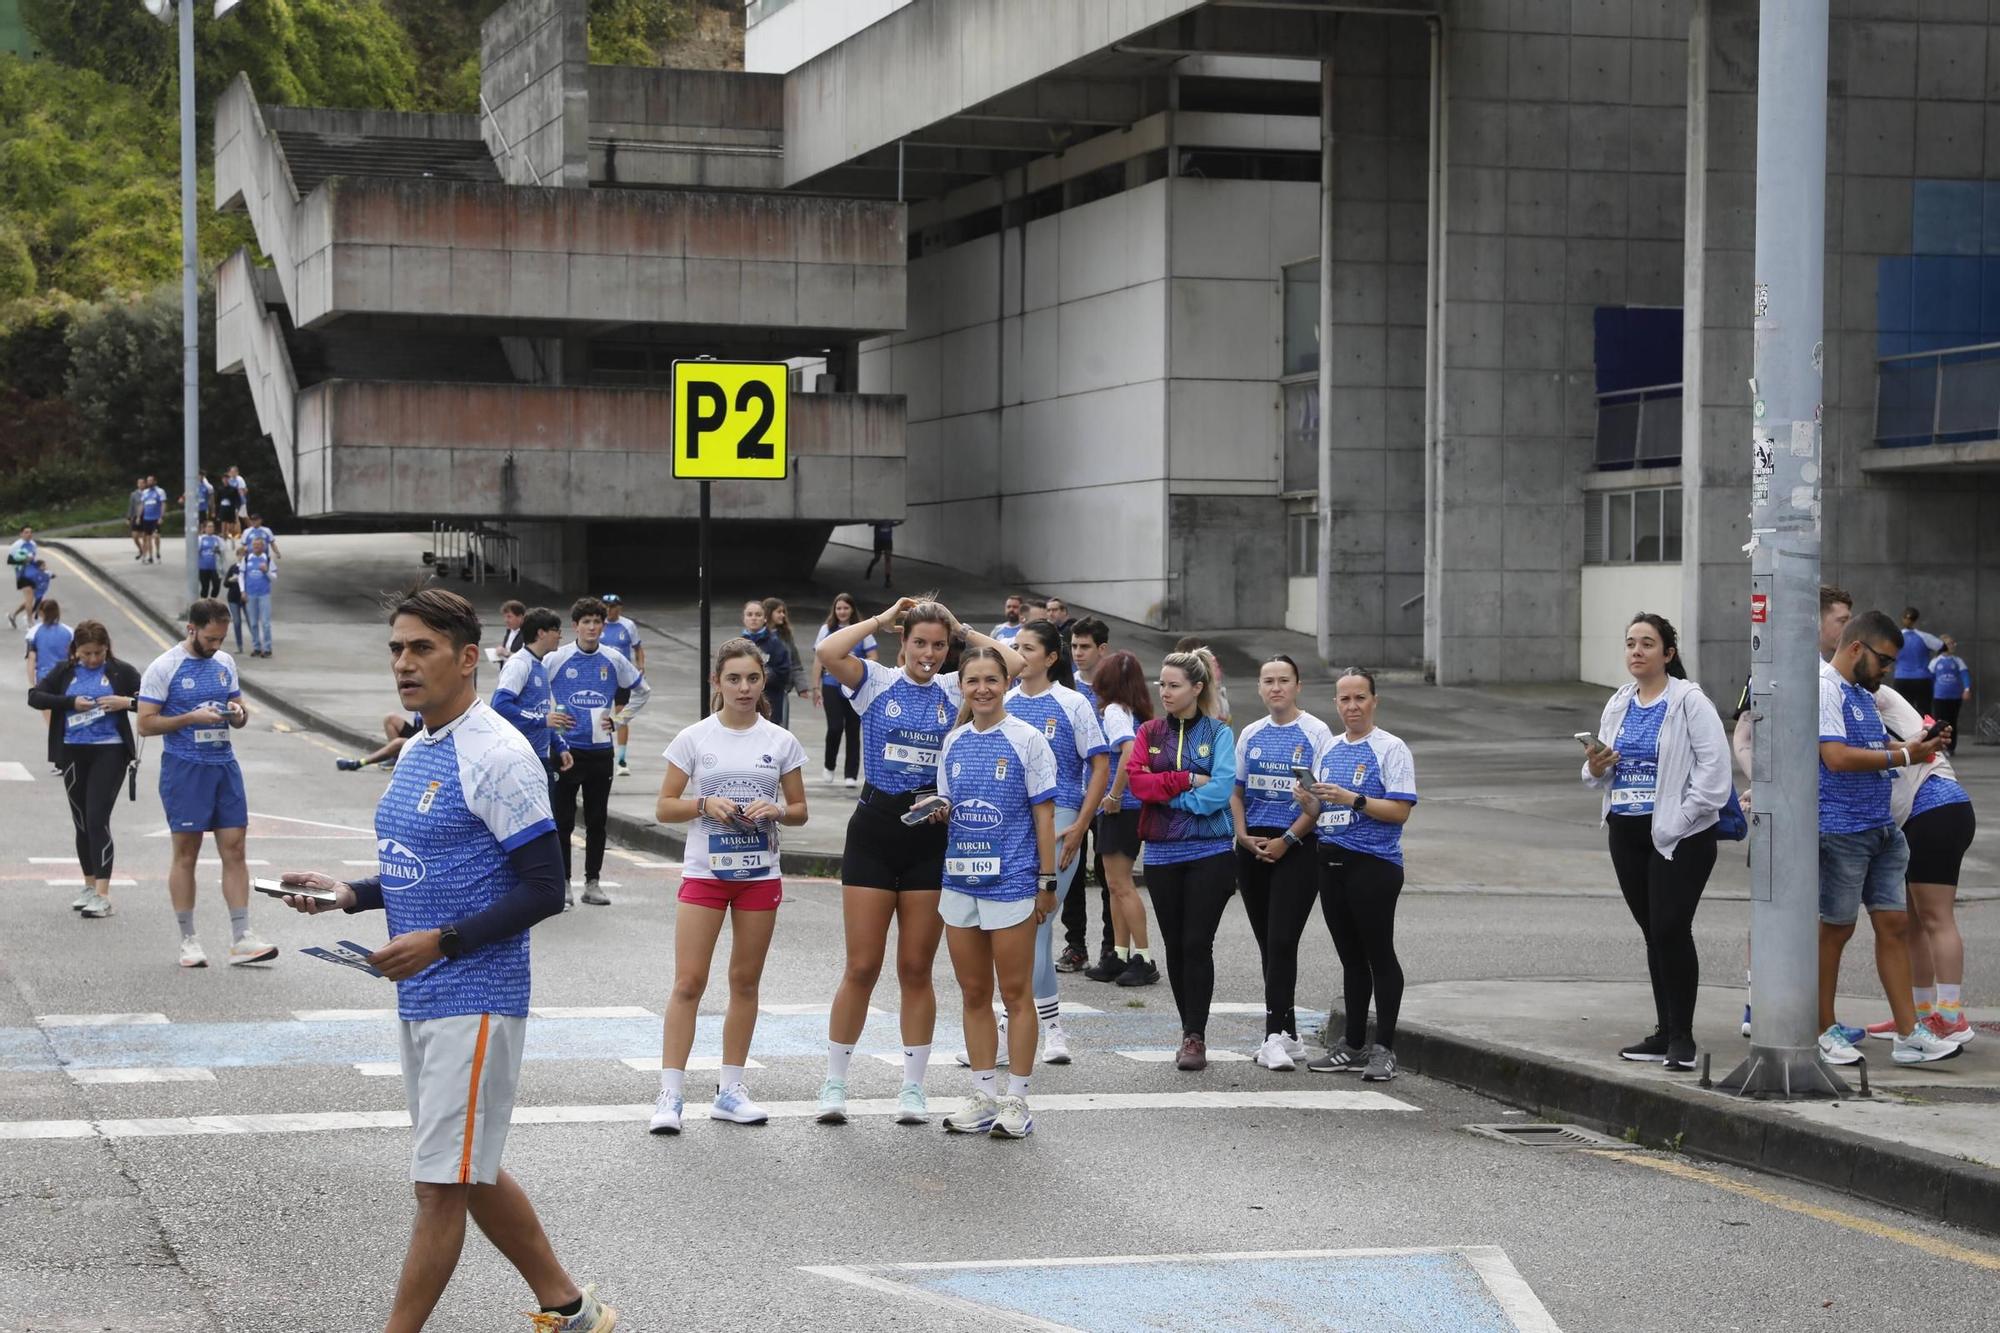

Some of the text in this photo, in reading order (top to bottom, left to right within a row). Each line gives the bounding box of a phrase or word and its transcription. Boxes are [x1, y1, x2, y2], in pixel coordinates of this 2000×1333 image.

[686, 380, 775, 460] P2
[900, 730, 939, 742] MARCHA
[1258, 761, 1289, 771] MARCHA
[1271, 778, 1291, 790] 492
[1621, 774, 1654, 782] MARCHA
[953, 809, 998, 823] ASTURIANA
[720, 836, 760, 845] MARCHA
[956, 841, 991, 850] MARCHA
[742, 855, 761, 867] 571
[972, 861, 992, 873] 169
[378, 861, 418, 880] URIANA
